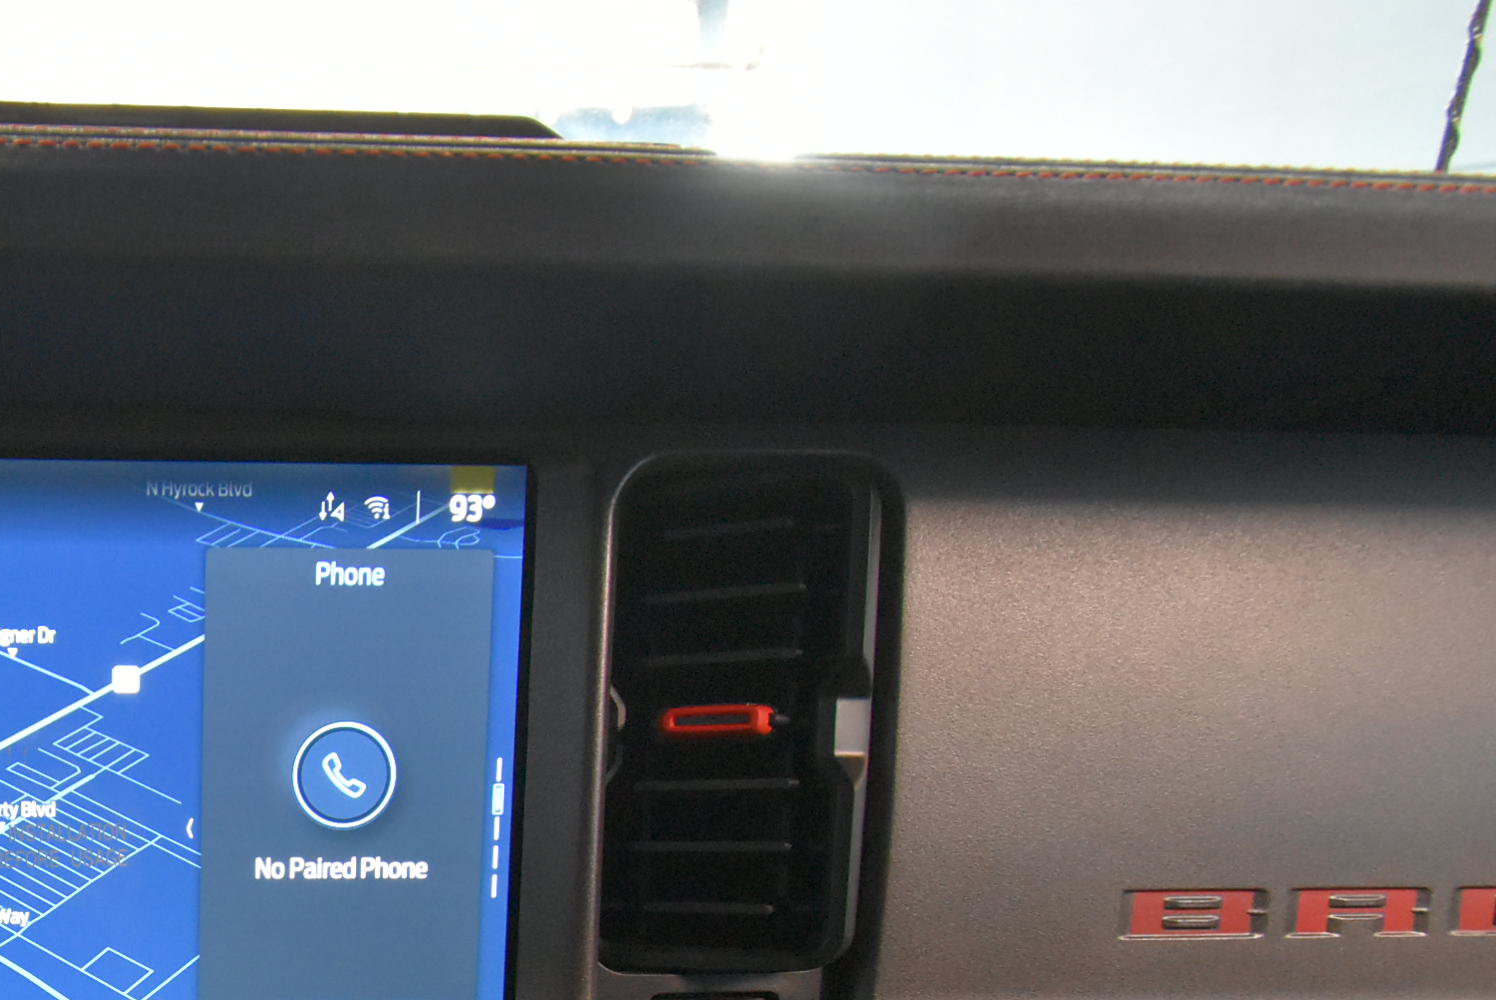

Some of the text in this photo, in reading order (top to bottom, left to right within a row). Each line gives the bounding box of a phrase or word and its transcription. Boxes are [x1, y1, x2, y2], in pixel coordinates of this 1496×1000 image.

[145, 480, 159, 497] N
[217, 480, 254, 498] Blvd
[314, 561, 385, 587] Phone
[37, 625, 56, 643] Dr
[20, 801, 57, 818] Blvd
[254, 856, 429, 881] No Paired Phone
[1118, 886, 1496, 940] BR
